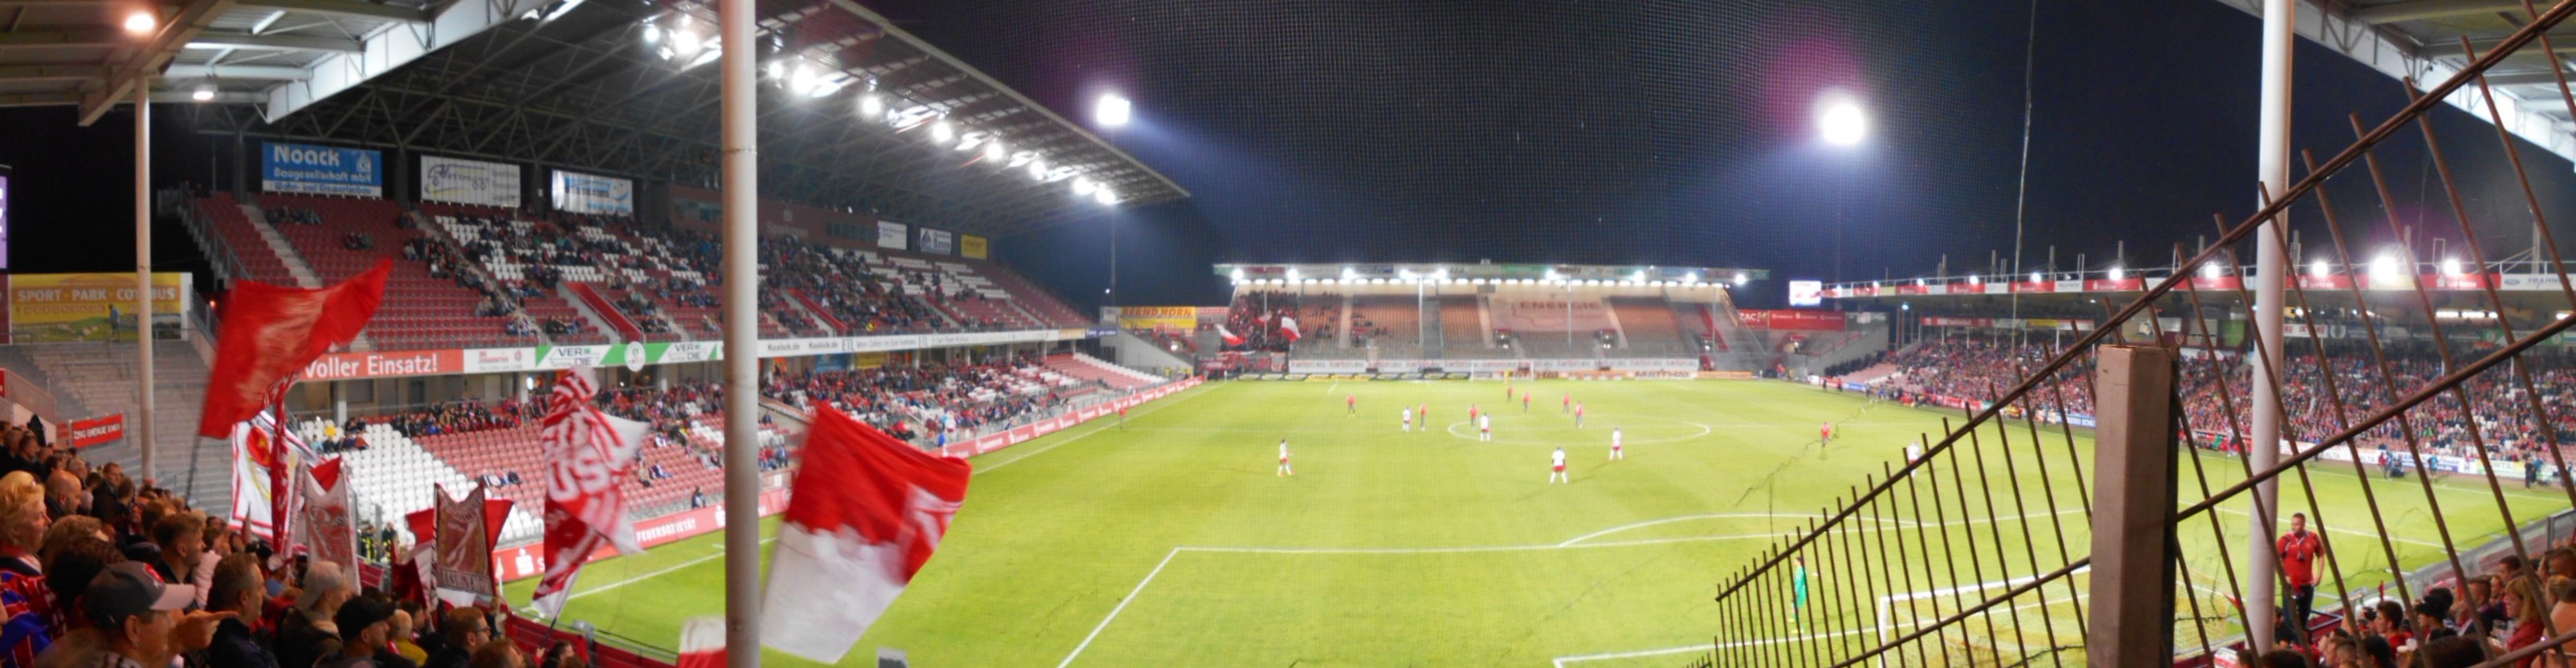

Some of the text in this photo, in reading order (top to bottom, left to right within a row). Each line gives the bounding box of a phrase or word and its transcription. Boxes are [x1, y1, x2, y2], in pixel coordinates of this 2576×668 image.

[274, 145, 340, 167] Noack
[274, 167, 348, 182] Baugesellschaft
[17, 288, 63, 303] SPORT
[71, 287, 108, 301] PARK
[558, 347, 583, 357] VER
[675, 344, 694, 352] VER
[305, 353, 438, 379] Voller Einsatz!
[636, 518, 696, 543] FEUERSOZIETÄT
